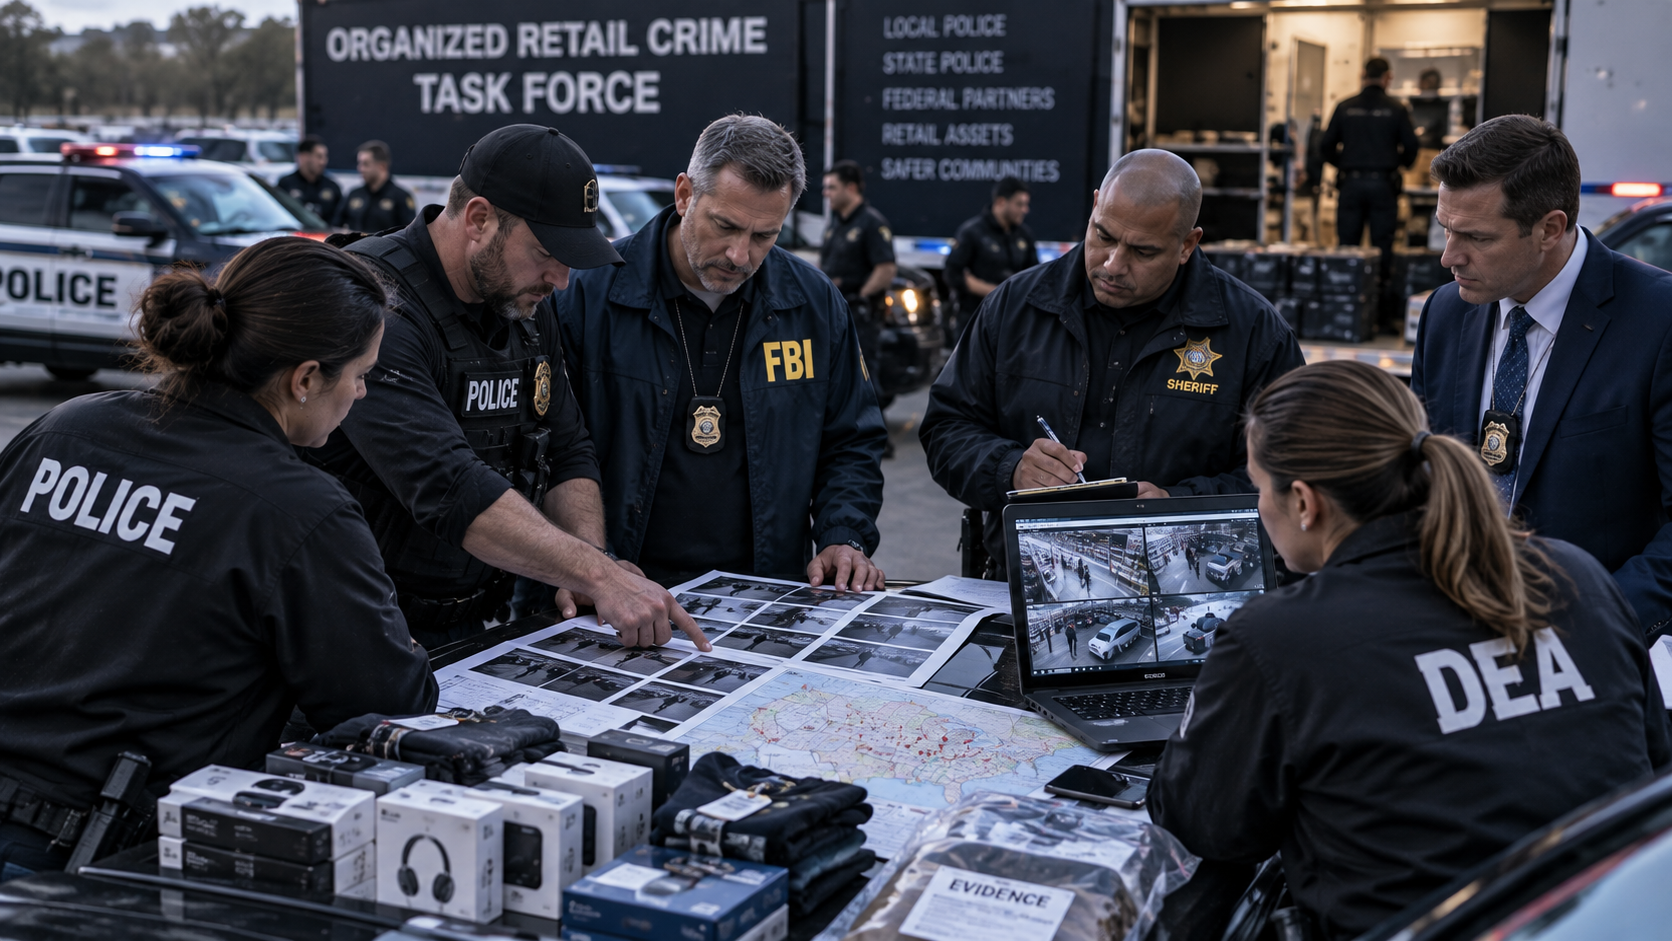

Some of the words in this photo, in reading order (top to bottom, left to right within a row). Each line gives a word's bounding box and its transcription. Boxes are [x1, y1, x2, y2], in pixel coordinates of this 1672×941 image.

[326, 24, 508, 61] ORGANIZED
[517, 20, 638, 58] RETAIL
[647, 17, 767, 55] CRIME
[883, 15, 940, 39] LOCAL
[943, 14, 1007, 38] POLICE
[882, 51, 937, 75] STATE
[940, 50, 1004, 74] POLICE
[413, 73, 512, 114] TASK
[522, 71, 660, 114] FORCE
[882, 87, 960, 110] FEDERAL
[962, 86, 1055, 110] PARTNERS
[882, 123, 942, 145] RETAIL
[944, 123, 1013, 146] ASSETS
[881, 157, 936, 181] SAFER
[938, 158, 1060, 183] COMMUNITIES
[0, 266, 117, 308] OLICE
[763, 338, 814, 382] FBI
[466, 378, 519, 411] POLICE
[1167, 378, 1219, 395] SHERIFF
[20, 457, 196, 554] POLICE
[1414, 626, 1595, 735] DEA
[949, 878, 1051, 908] EVIDENCE
